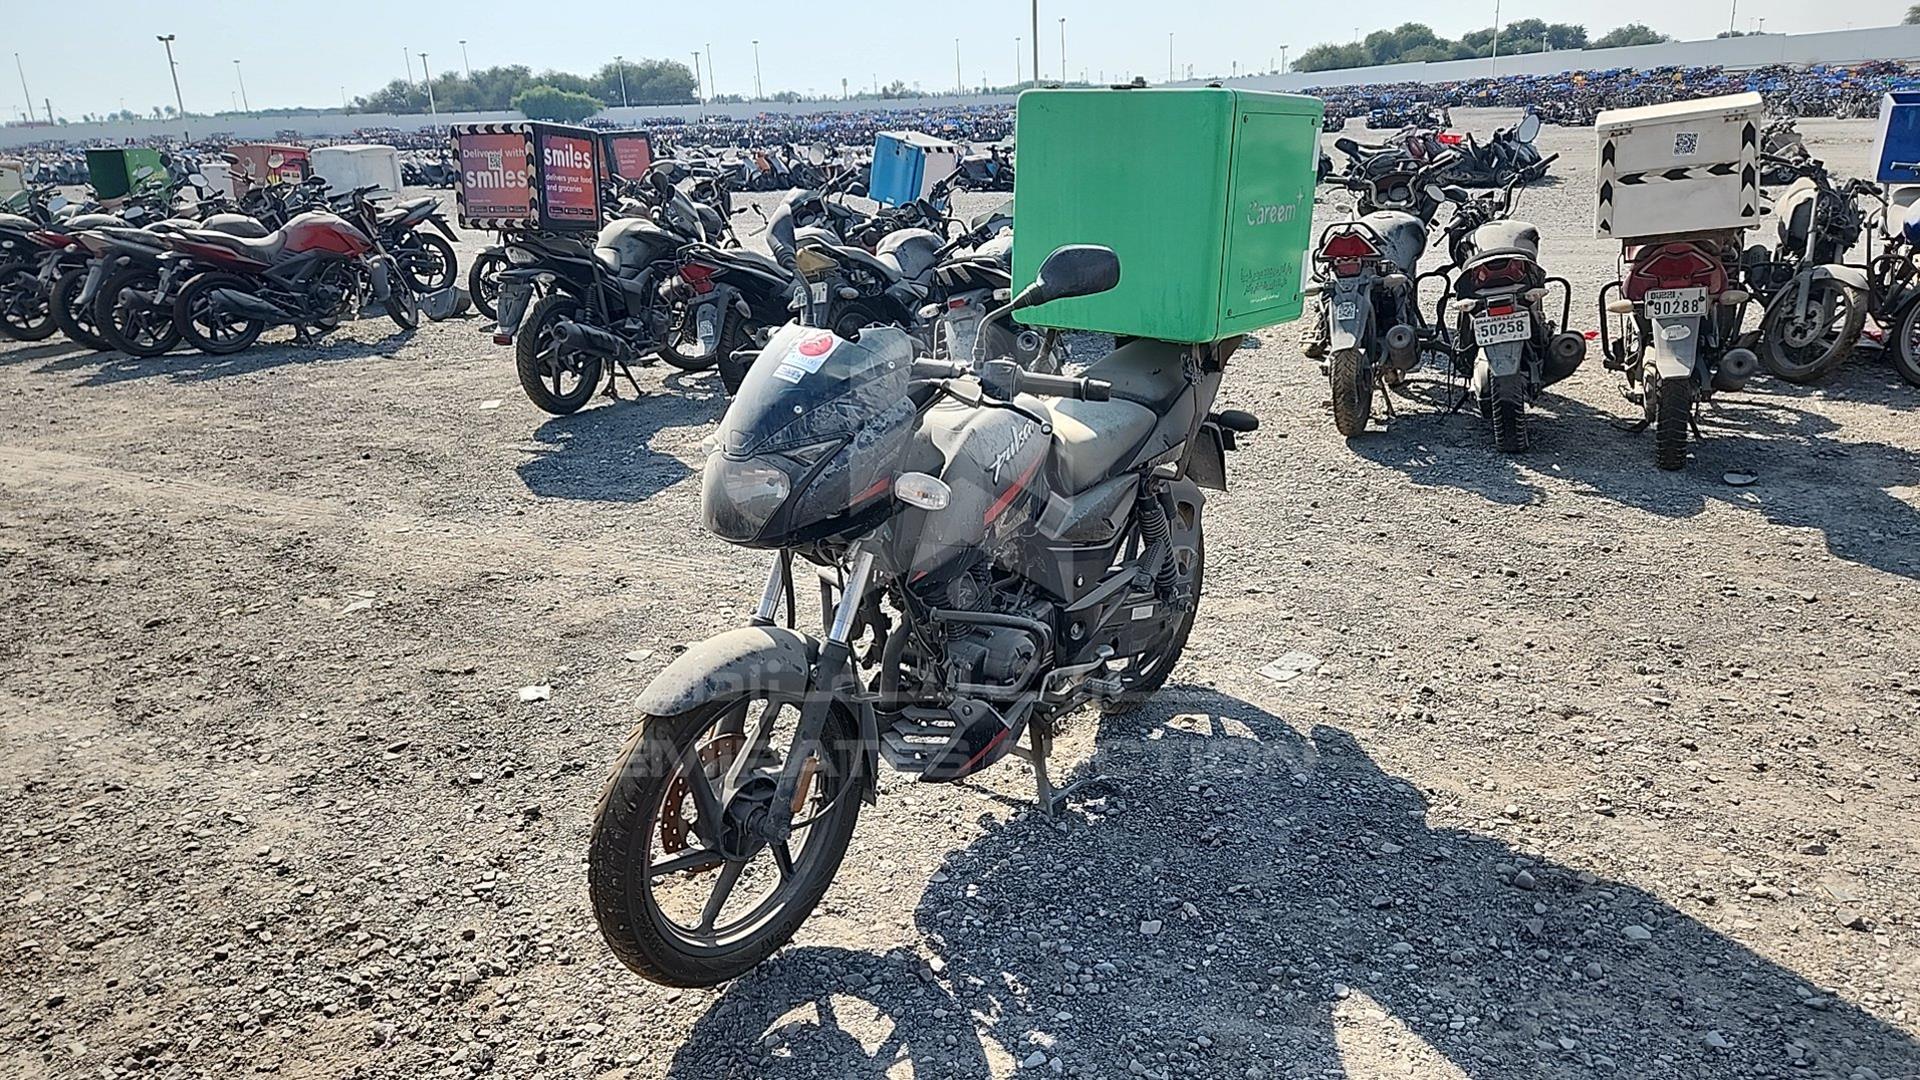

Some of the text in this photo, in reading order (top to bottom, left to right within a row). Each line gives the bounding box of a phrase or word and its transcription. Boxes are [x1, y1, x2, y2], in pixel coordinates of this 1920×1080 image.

[463, 148, 524, 158] Delived with
[543, 143, 592, 169] smiles
[466, 162, 528, 189] smiles
[546, 173, 566, 182] delivers
[567, 175, 579, 183] your
[558, 185, 583, 193] groceries
[1654, 299, 1699, 315] 90288
[1480, 320, 1525, 337] 50258
[984, 419, 1035, 486] pulsa
